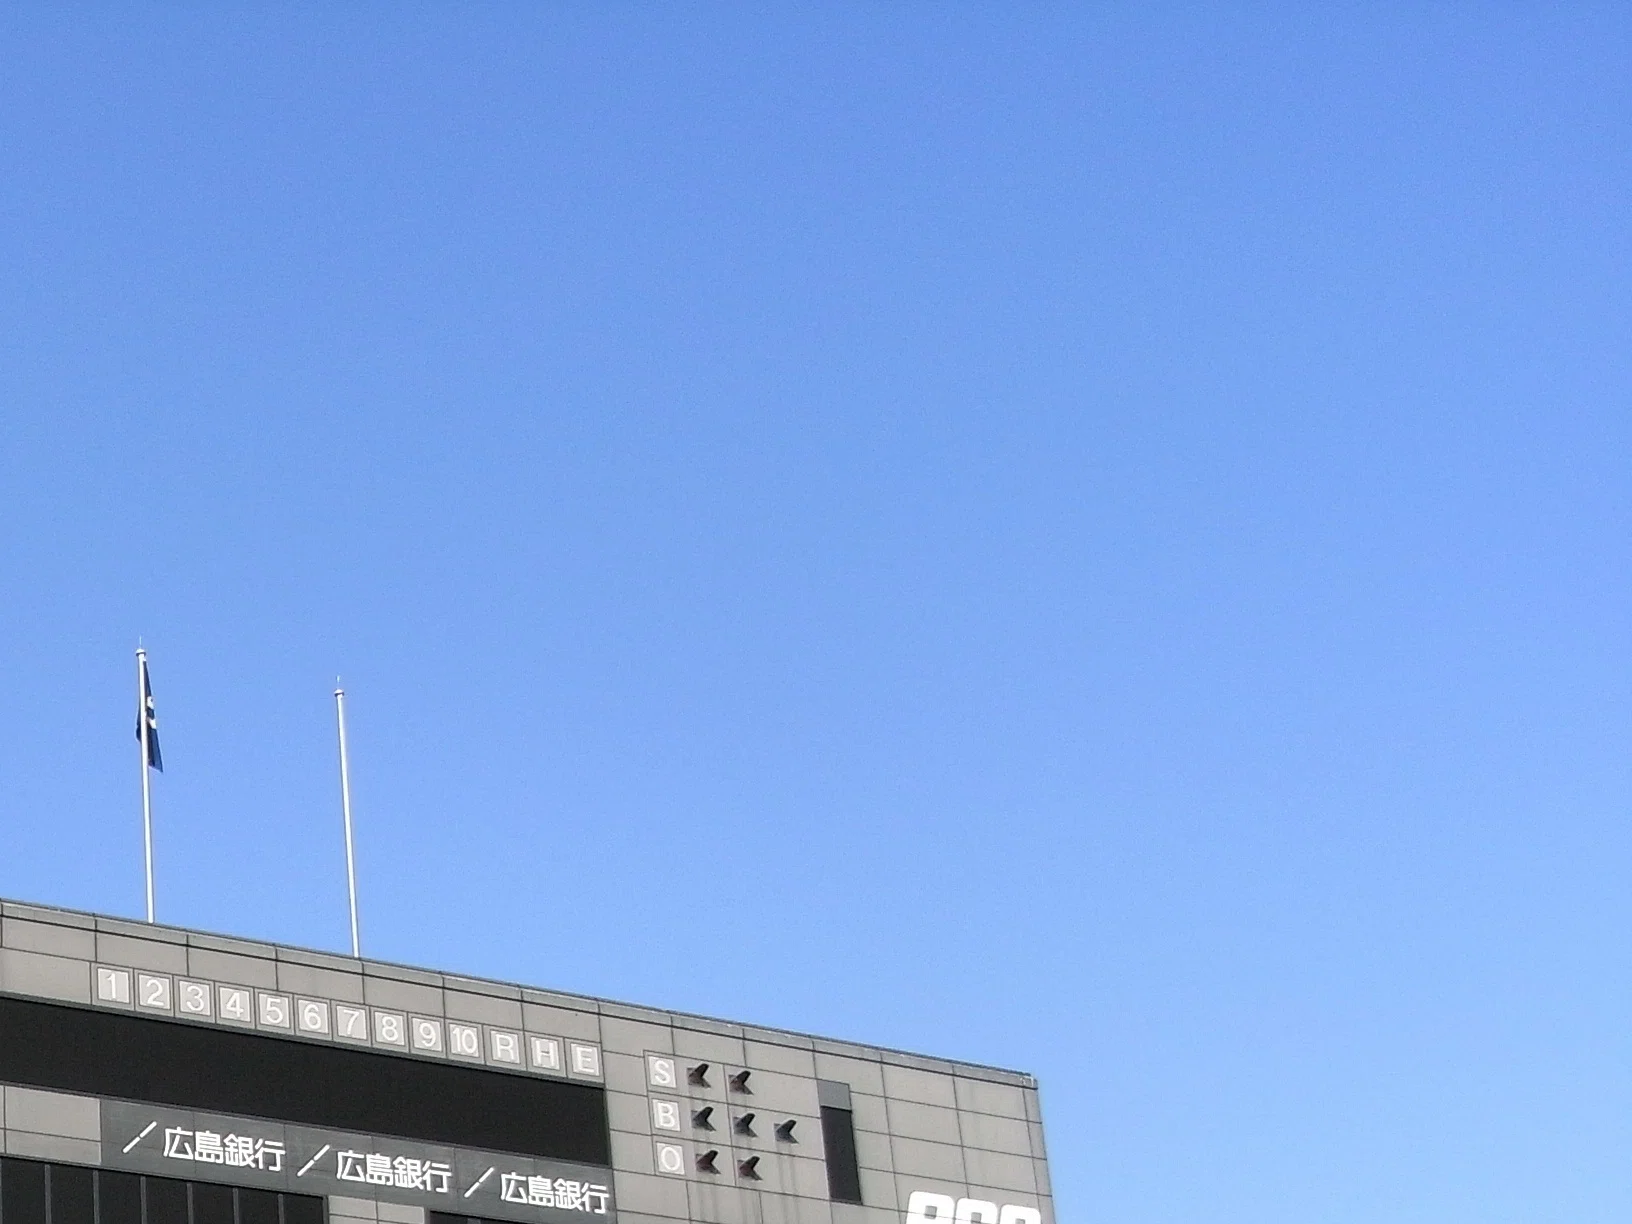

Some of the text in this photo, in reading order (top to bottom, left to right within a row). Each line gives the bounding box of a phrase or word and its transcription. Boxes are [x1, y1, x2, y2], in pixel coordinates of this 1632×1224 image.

[107, 972, 595, 1073] 1 2 3 4 5 6 7 8 9 10 R H E
[654, 1060, 670, 1084] S
[658, 1103, 675, 1127] B
[163, 1126, 610, 1214] 広島銀行 広島銀行 広島銀行
[661, 1146, 680, 1171] O
